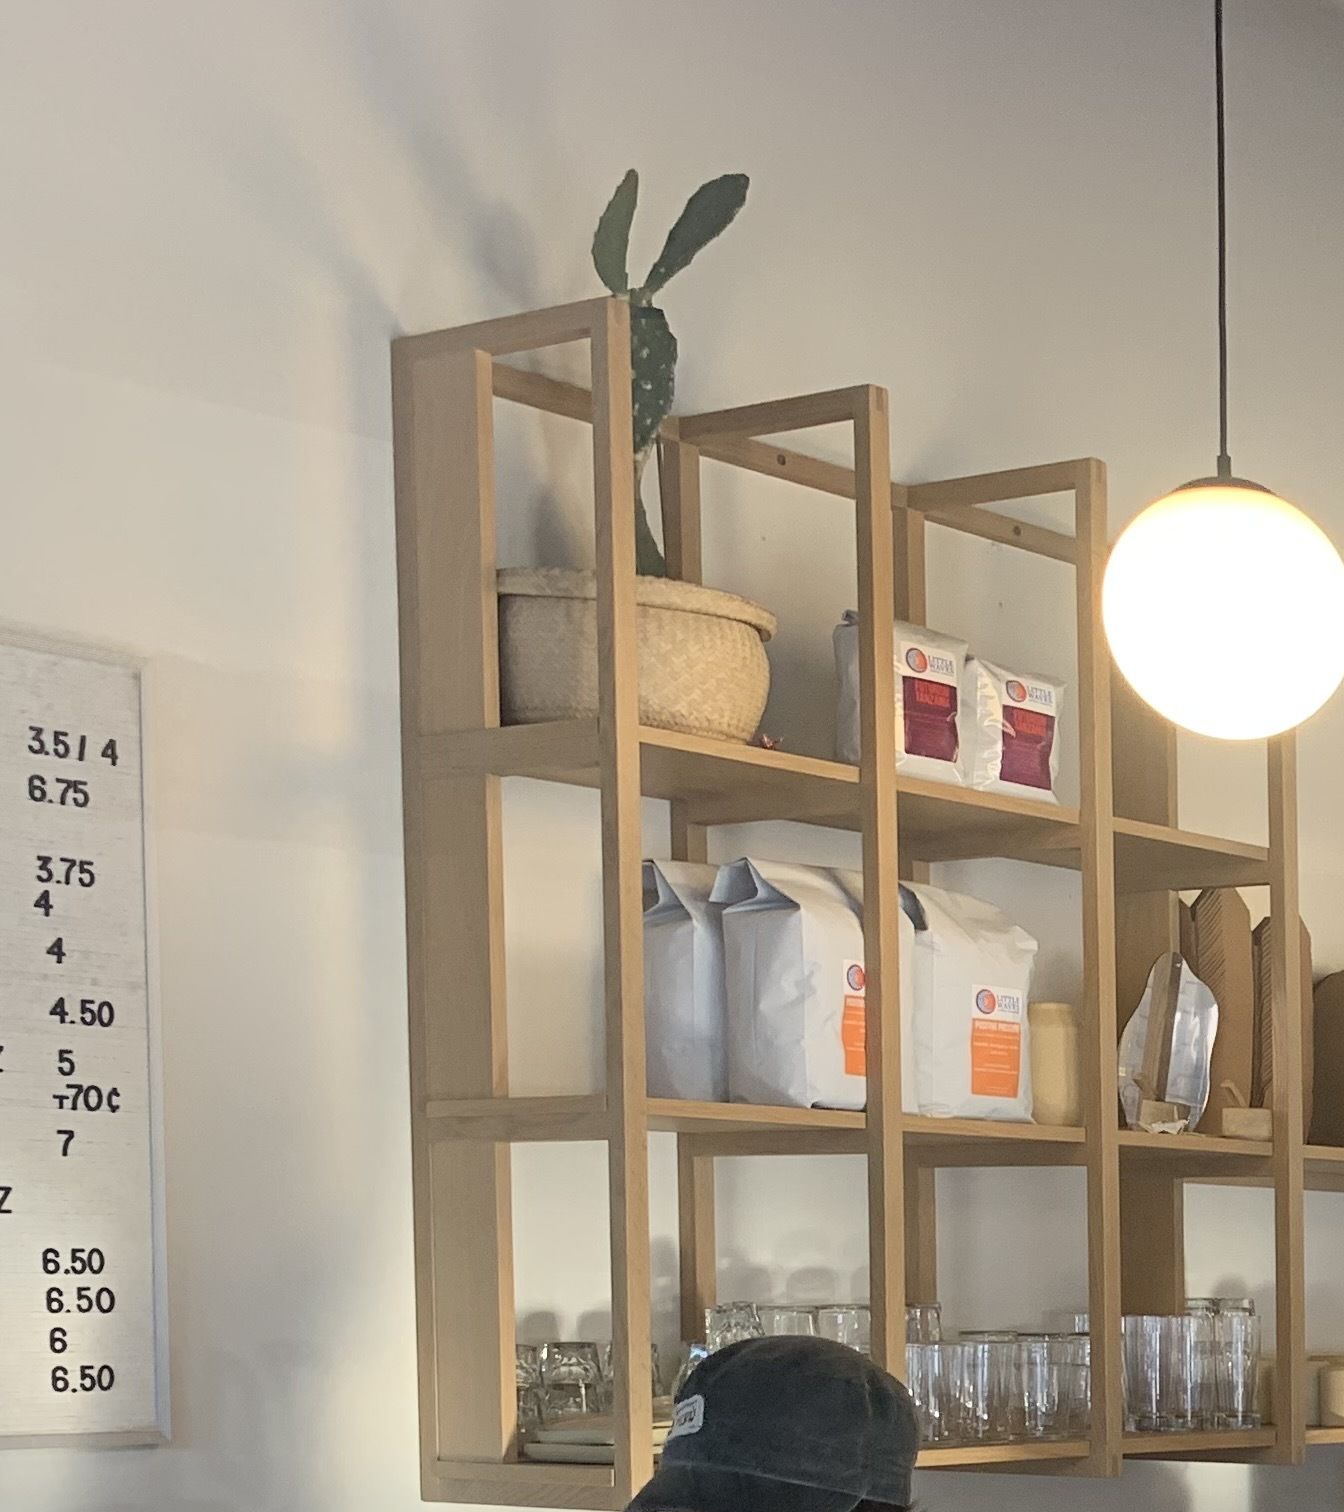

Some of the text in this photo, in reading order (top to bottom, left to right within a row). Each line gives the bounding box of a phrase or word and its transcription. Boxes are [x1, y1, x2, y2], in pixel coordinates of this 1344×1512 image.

[28, 774, 90, 808] 6.75
[36, 855, 95, 888] 3.75
[33, 889, 54, 917] 4
[46, 937, 67, 964] 4
[49, 997, 115, 1028] 4.50
[57, 1049, 76, 1077] 5
[56, 1129, 75, 1157] 7
[42, 1247, 105, 1275] 6.50
[46, 1287, 116, 1314] 6.50
[49, 1327, 68, 1354] 6
[51, 1364, 115, 1393] 6.50
